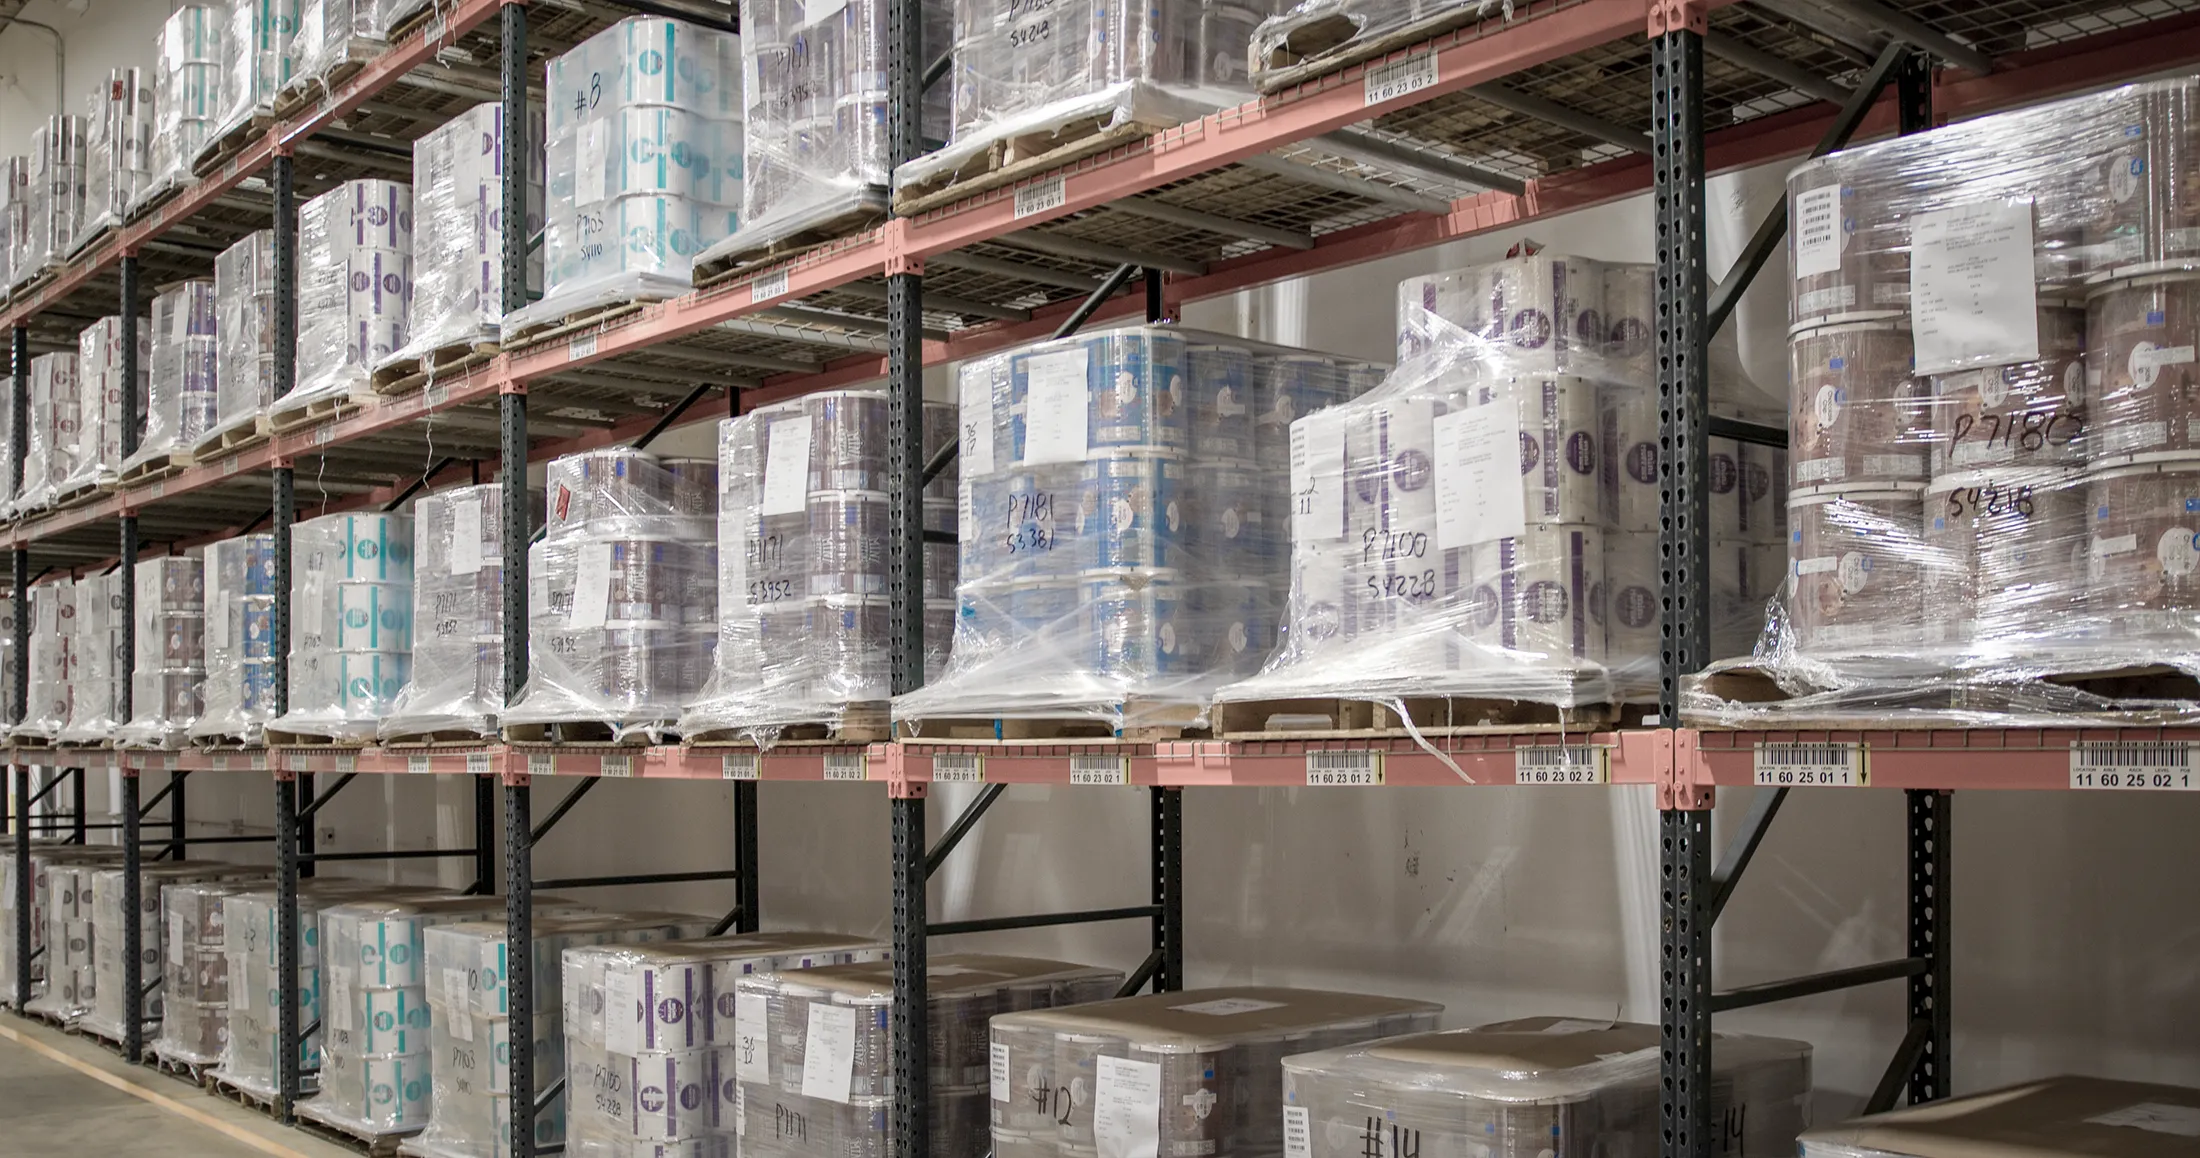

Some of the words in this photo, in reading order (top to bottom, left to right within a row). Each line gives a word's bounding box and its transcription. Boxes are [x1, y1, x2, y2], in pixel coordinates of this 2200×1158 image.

[1369, 91, 1378, 102] 11
[1382, 87, 1392, 98] 60
[1396, 82, 1407, 94] 23
[1412, 77, 1422, 89] 03
[1427, 74, 1433, 84] 2
[1017, 207, 1024, 216] 11
[1026, 204, 1034, 213] 60
[1036, 200, 1044, 210] 23
[1058, 195, 1061, 204] 1
[1949, 411, 2083, 459] P7180
[1007, 493, 1054, 528] P7181
[1362, 527, 1428, 566] P7100
[936, 772, 942, 780] 11
[944, 772, 950, 780] 60
[953, 772, 960, 780] 23
[962, 772, 968, 780] 01
[1073, 774, 1080, 782] 11
[1082, 774, 1091, 782] 60
[1094, 774, 1102, 782] 23
[1104, 774, 1112, 783] 02
[1116, 774, 1120, 783] 1
[1310, 774, 1319, 783] 11
[1323, 774, 1333, 784] 60
[1336, 774, 1347, 784] 23
[1350, 774, 1360, 783] 01
[1366, 774, 1370, 783] 2
[1520, 772, 1530, 782] 11
[1536, 772, 1548, 782] 60
[1552, 772, 1564, 782] 23
[1570, 772, 1582, 782] 02
[1588, 772, 1594, 782] 2
[1760, 772, 1772, 783] 11
[1779, 772, 1793, 783] 60
[1799, 772, 1814, 783] 25
[1820, 772, 1834, 784] 01
[1842, 772, 1848, 784] 1
[2076, 774, 2092, 786] 11
[2101, 774, 2118, 786] 60
[2127, 774, 2145, 786] 25
[2153, 774, 2172, 787] 02
[2182, 774, 2188, 787] 1
